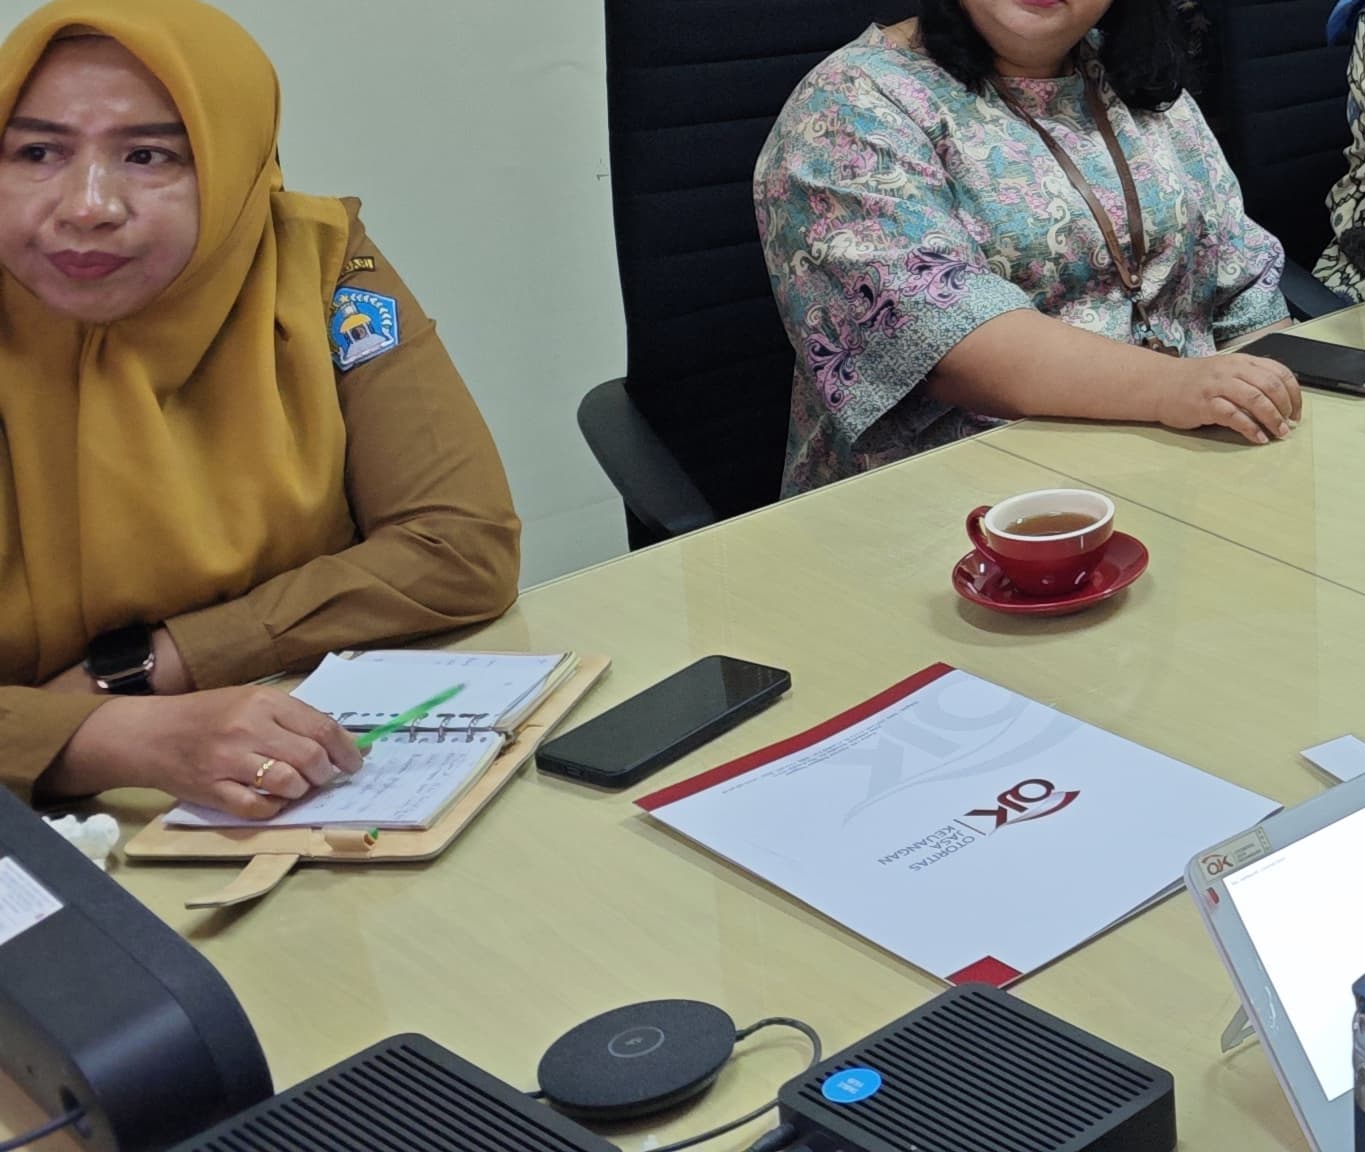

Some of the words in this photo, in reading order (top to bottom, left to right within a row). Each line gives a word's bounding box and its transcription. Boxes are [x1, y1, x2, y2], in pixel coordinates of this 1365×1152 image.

[877, 824, 956, 867] KEUANGAN
[908, 835, 976, 873] OTORITAS
[929, 829, 965, 850] JASA
